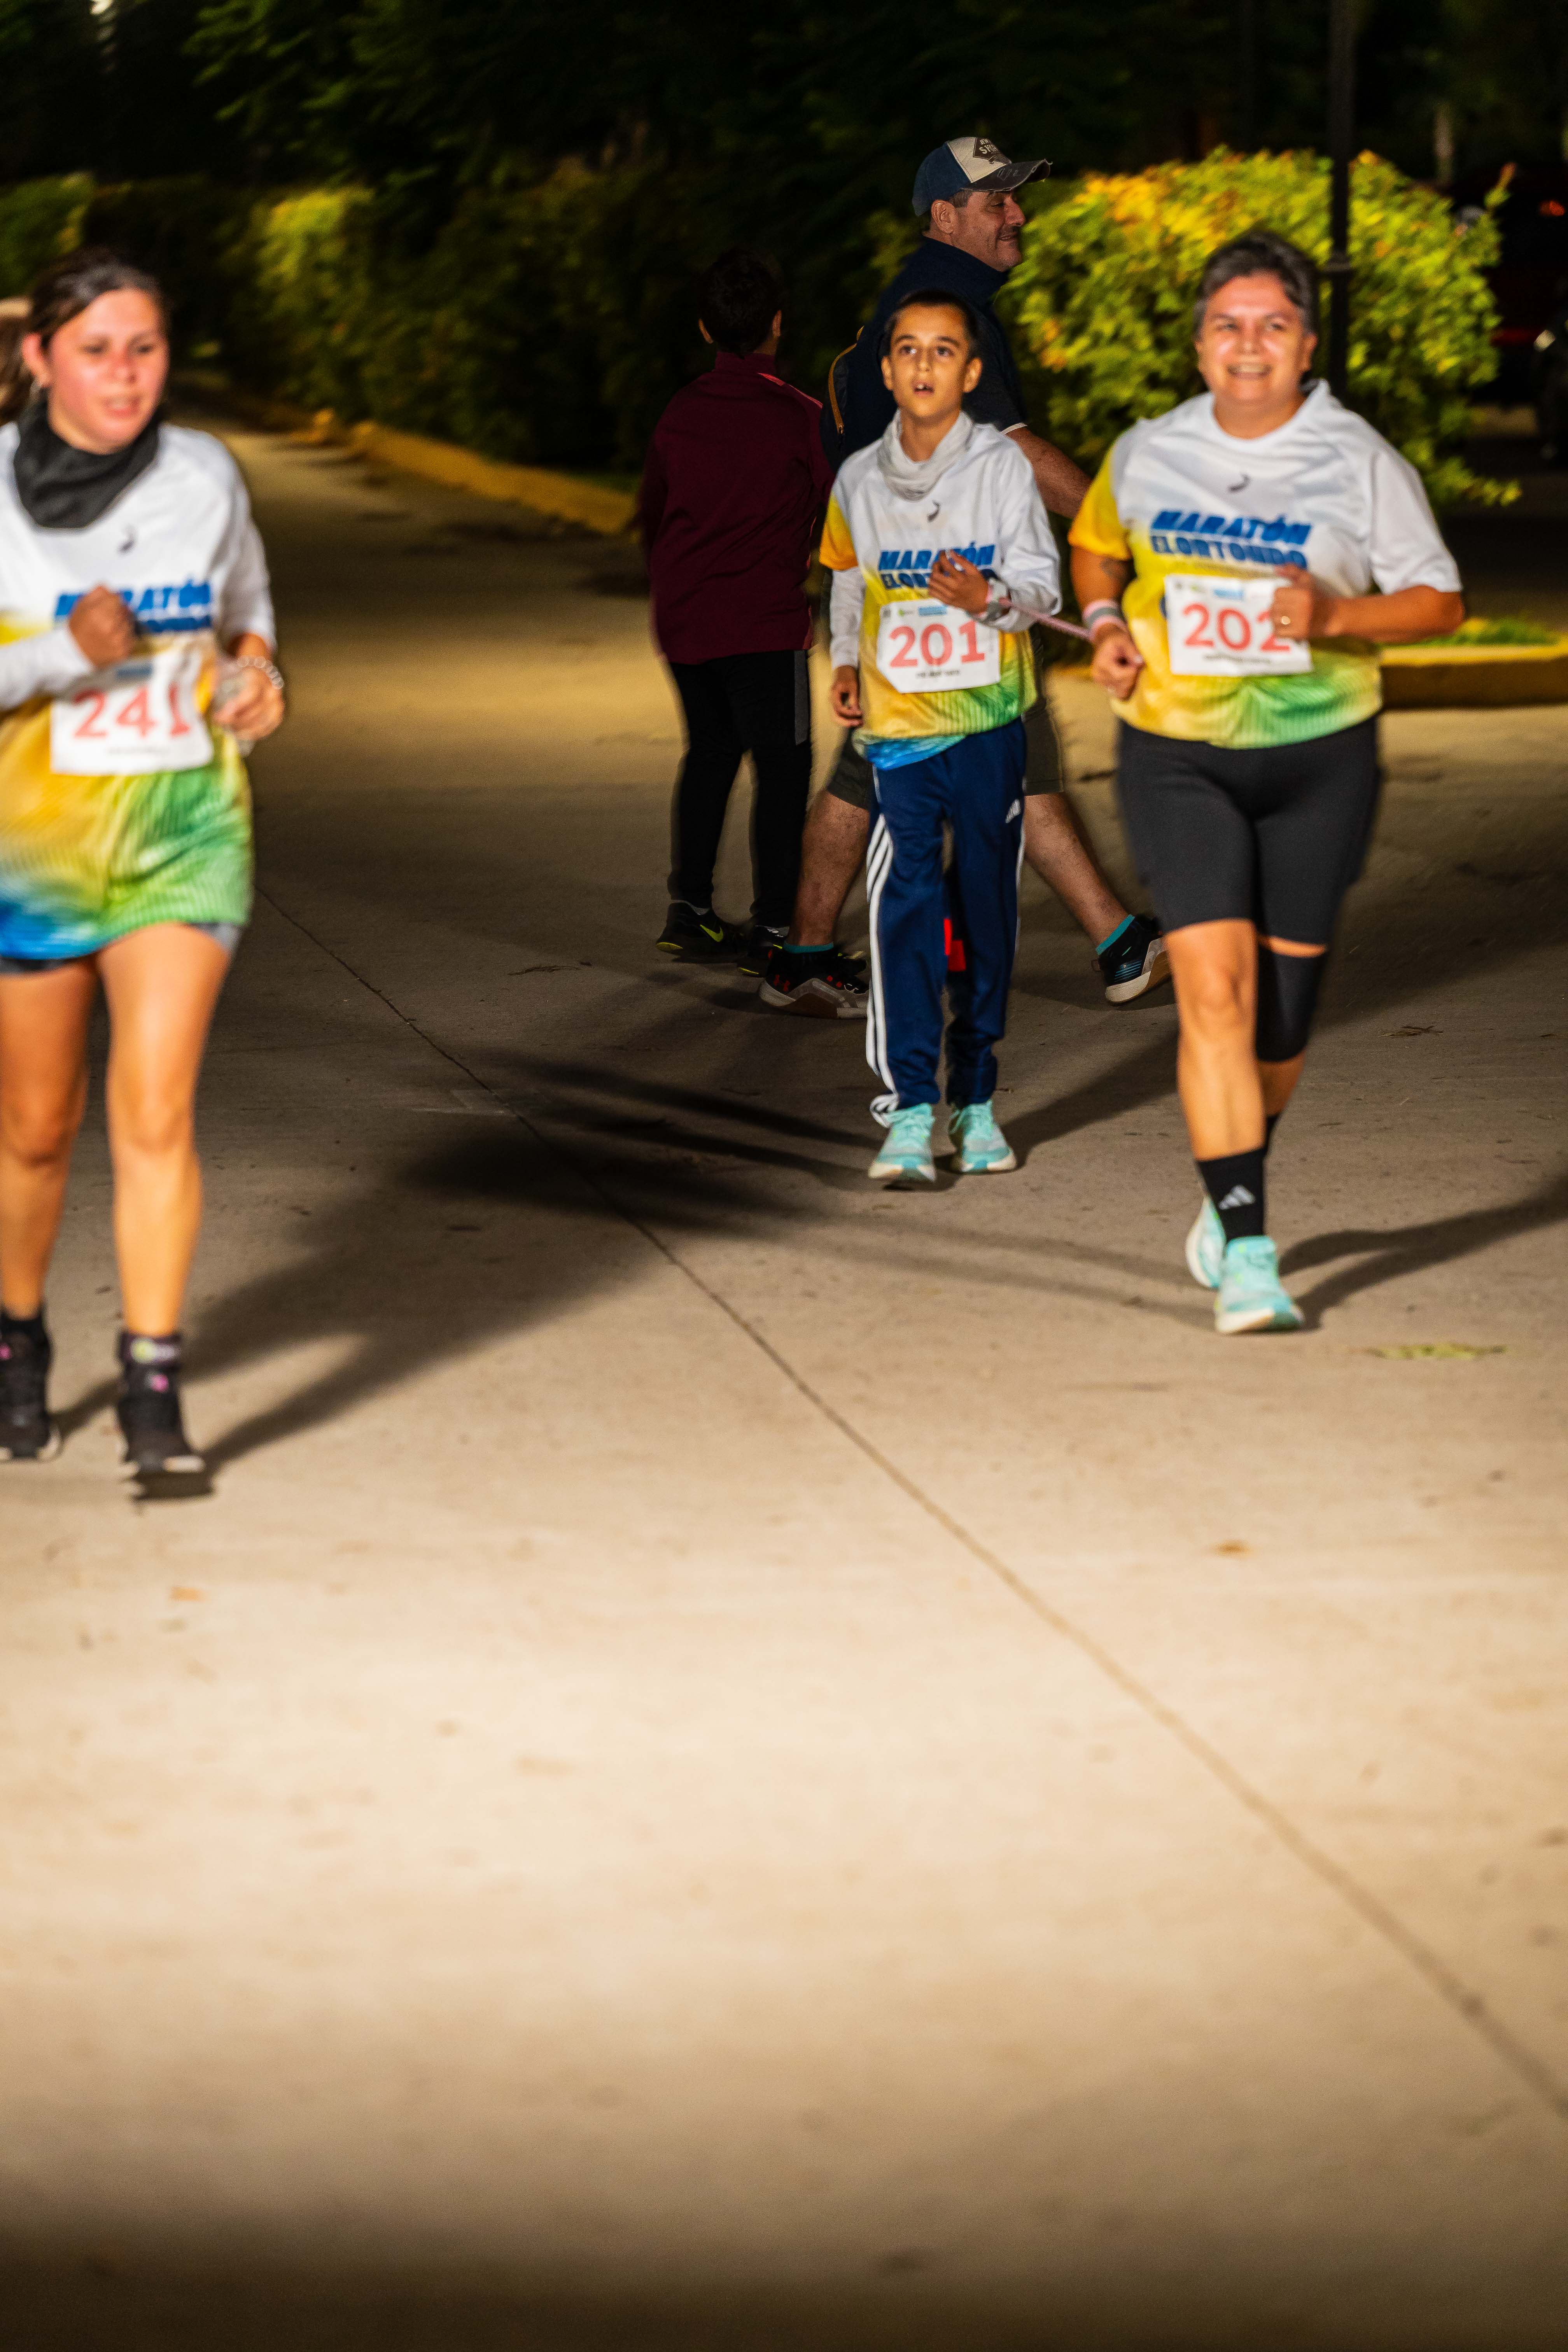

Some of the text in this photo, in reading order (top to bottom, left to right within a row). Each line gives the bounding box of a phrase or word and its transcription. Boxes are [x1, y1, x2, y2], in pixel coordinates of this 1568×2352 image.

[1152, 510, 1311, 545] MARATÓN
[878, 541, 995, 570] MARÓN
[55, 576, 211, 616] MATÓN
[889, 620, 986, 668] 201
[72, 683, 190, 738] 241
